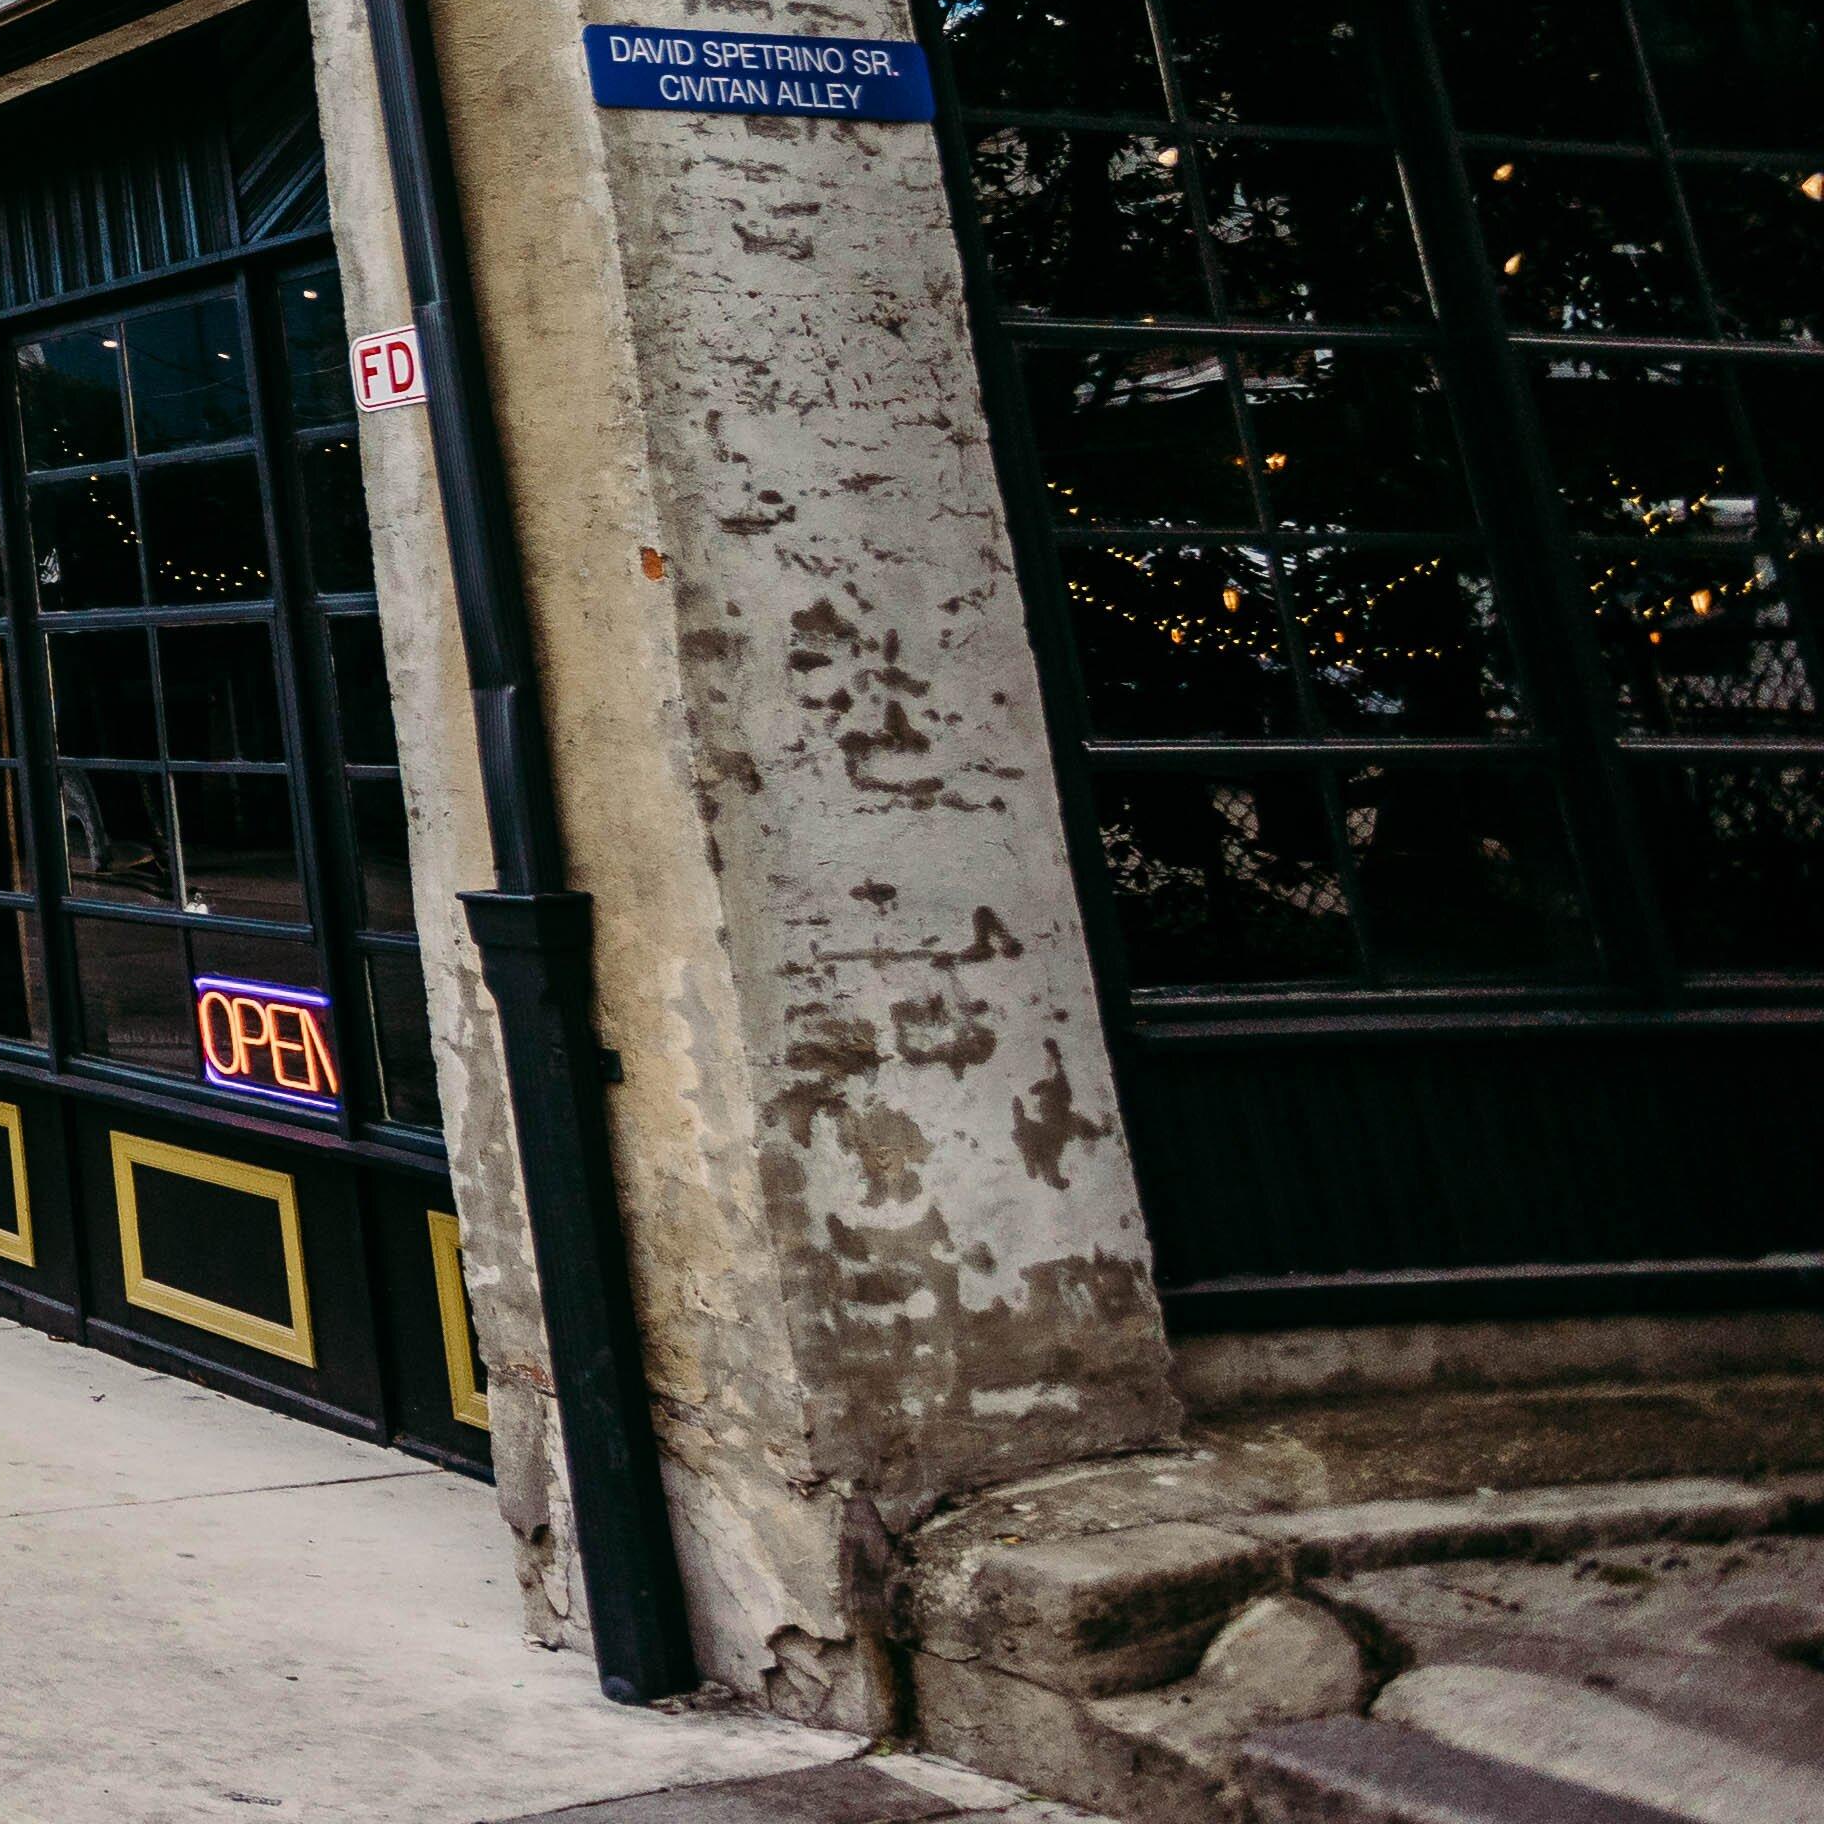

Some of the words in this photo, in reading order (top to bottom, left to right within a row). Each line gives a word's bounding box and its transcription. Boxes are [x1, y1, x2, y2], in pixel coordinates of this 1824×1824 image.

[609, 35, 696, 65] DAVID
[703, 41, 844, 74] SPETRINO
[853, 49, 899, 76] SR.
[660, 74, 769, 105] CIVITAN
[777, 80, 862, 109] ALLEY
[359, 340, 415, 399] FD
[200, 991, 340, 1095] OPEN
